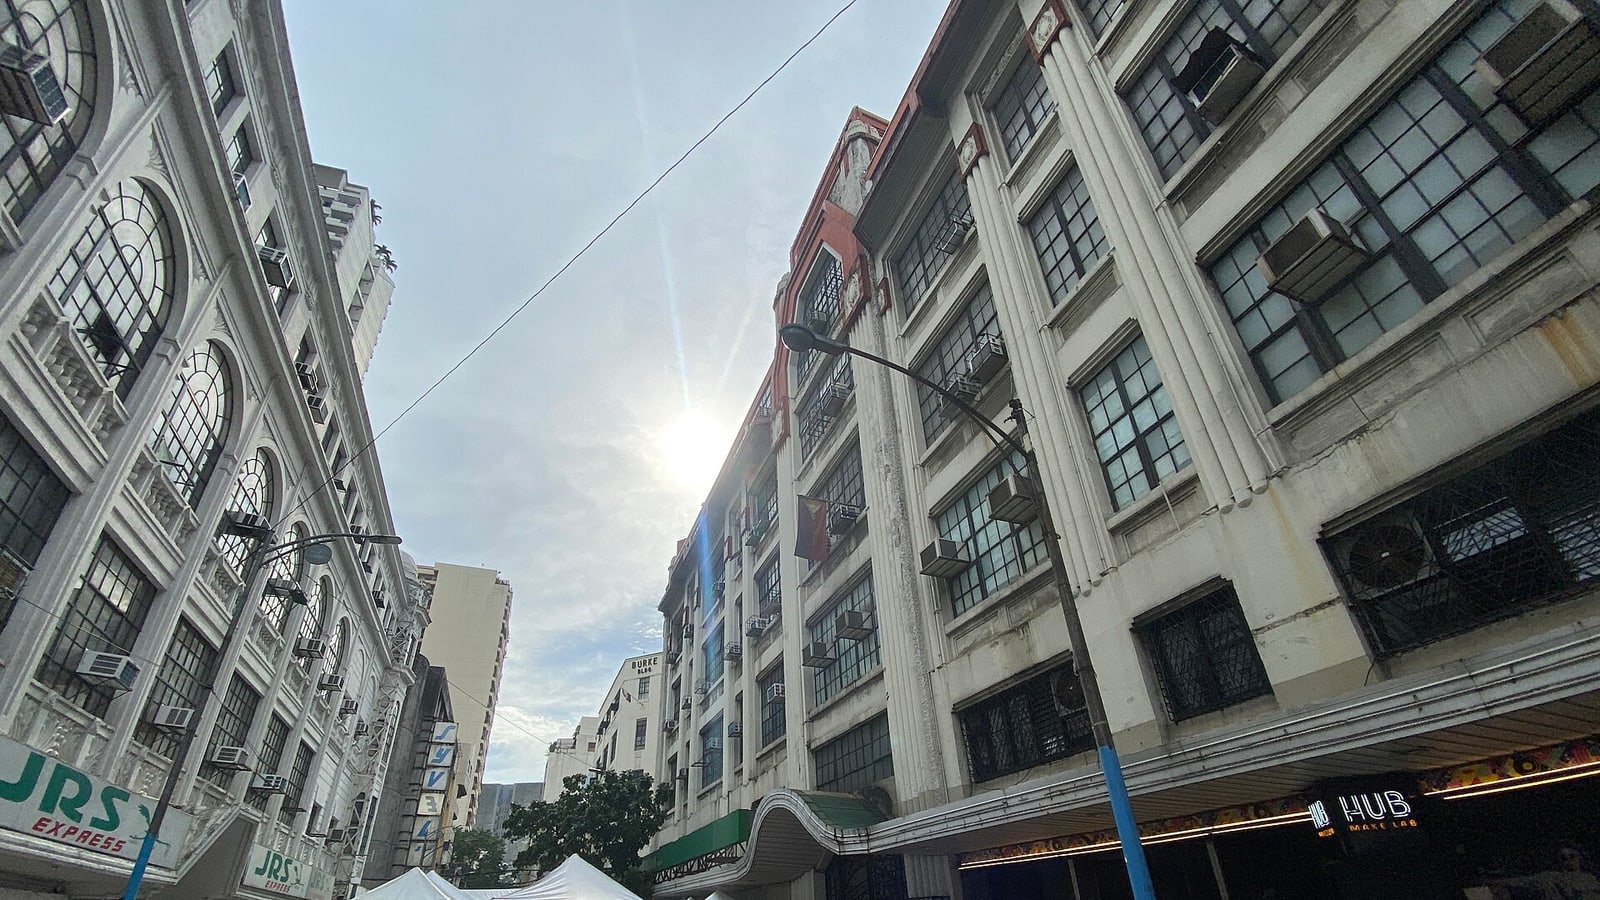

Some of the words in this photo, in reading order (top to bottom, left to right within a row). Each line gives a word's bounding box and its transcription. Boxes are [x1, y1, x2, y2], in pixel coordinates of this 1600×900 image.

[632, 657, 658, 669] BURKE
[0, 752, 130, 832] JRS
[1338, 790, 1411, 822] HUB
[32, 817, 126, 852] EXPRESS
[1349, 822, 1386, 832] MAKE
[1392, 819, 1418, 828] LAB
[255, 850, 293, 883] JRS
[265, 880, 291, 893] EXPRESS
